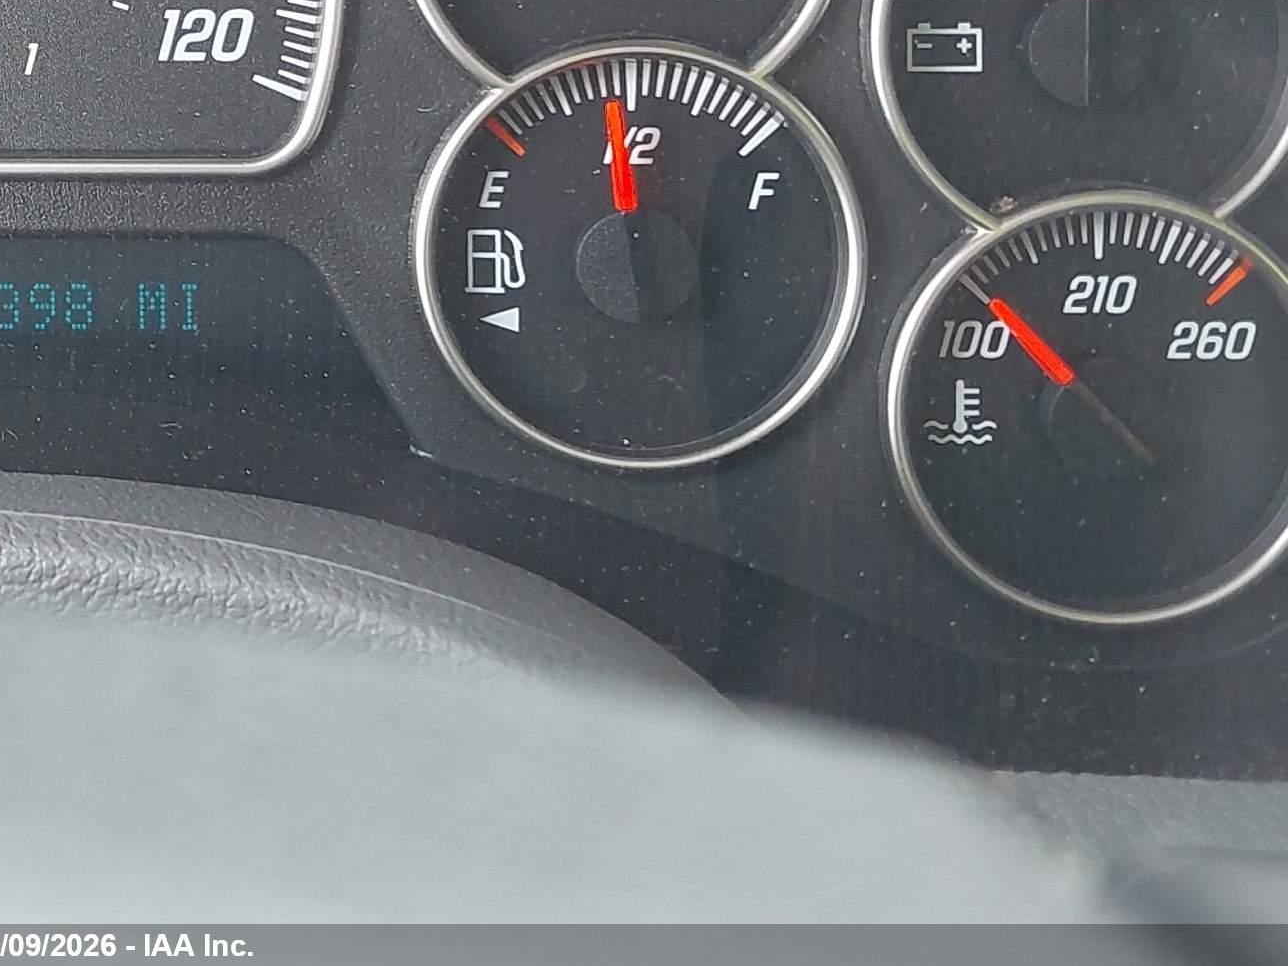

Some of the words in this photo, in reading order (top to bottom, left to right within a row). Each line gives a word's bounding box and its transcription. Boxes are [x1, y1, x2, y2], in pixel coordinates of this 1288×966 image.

[157, 9, 254, 62] 120
[24, 44, 39, 76] 1
[478, 171, 510, 208] E
[747, 172, 780, 210] F
[138, 283, 200, 330] MI
[1062, 275, 1136, 314] 210
[939, 320, 1010, 358] 100
[1167, 321, 1256, 360] 260
